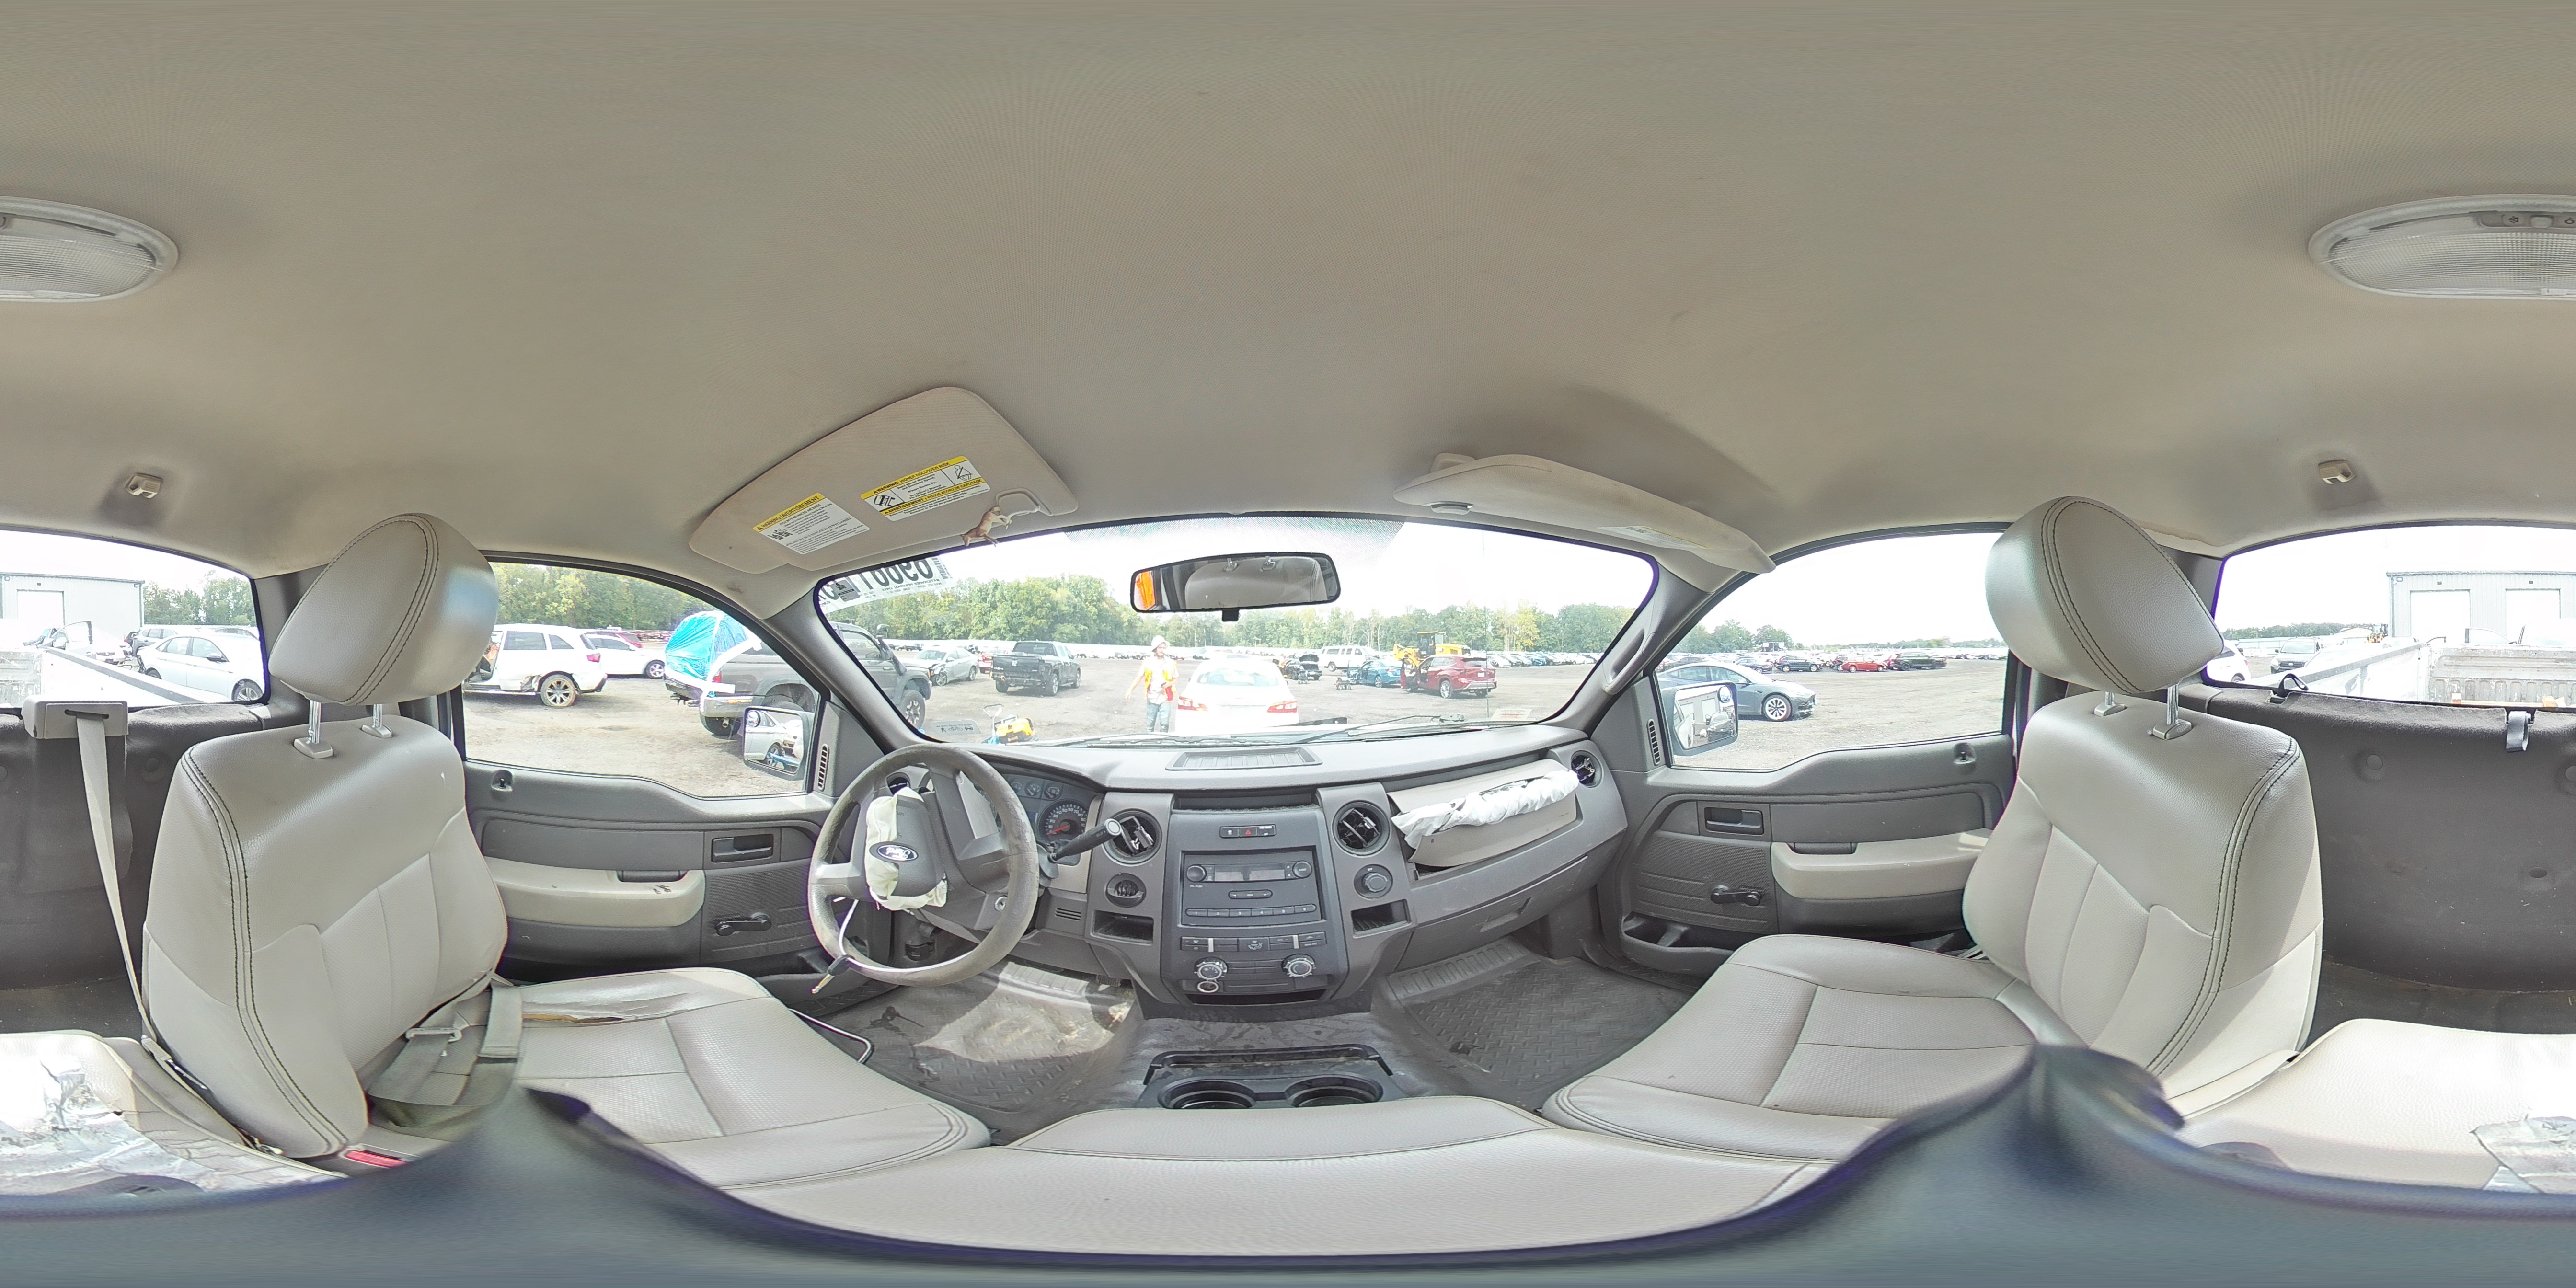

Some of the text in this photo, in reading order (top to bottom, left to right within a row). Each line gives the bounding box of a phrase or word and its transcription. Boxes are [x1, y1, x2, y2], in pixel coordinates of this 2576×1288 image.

[875, 481, 900, 492] WARNING:
[899, 474, 916, 483] HIGHER
[915, 465, 940, 477] ROLLOVER
[887, 497, 924, 512] AVERTISSEMENT
[959, 478, 982, 488] CAPOTAGE
[761, 516, 782, 528] WARNING
